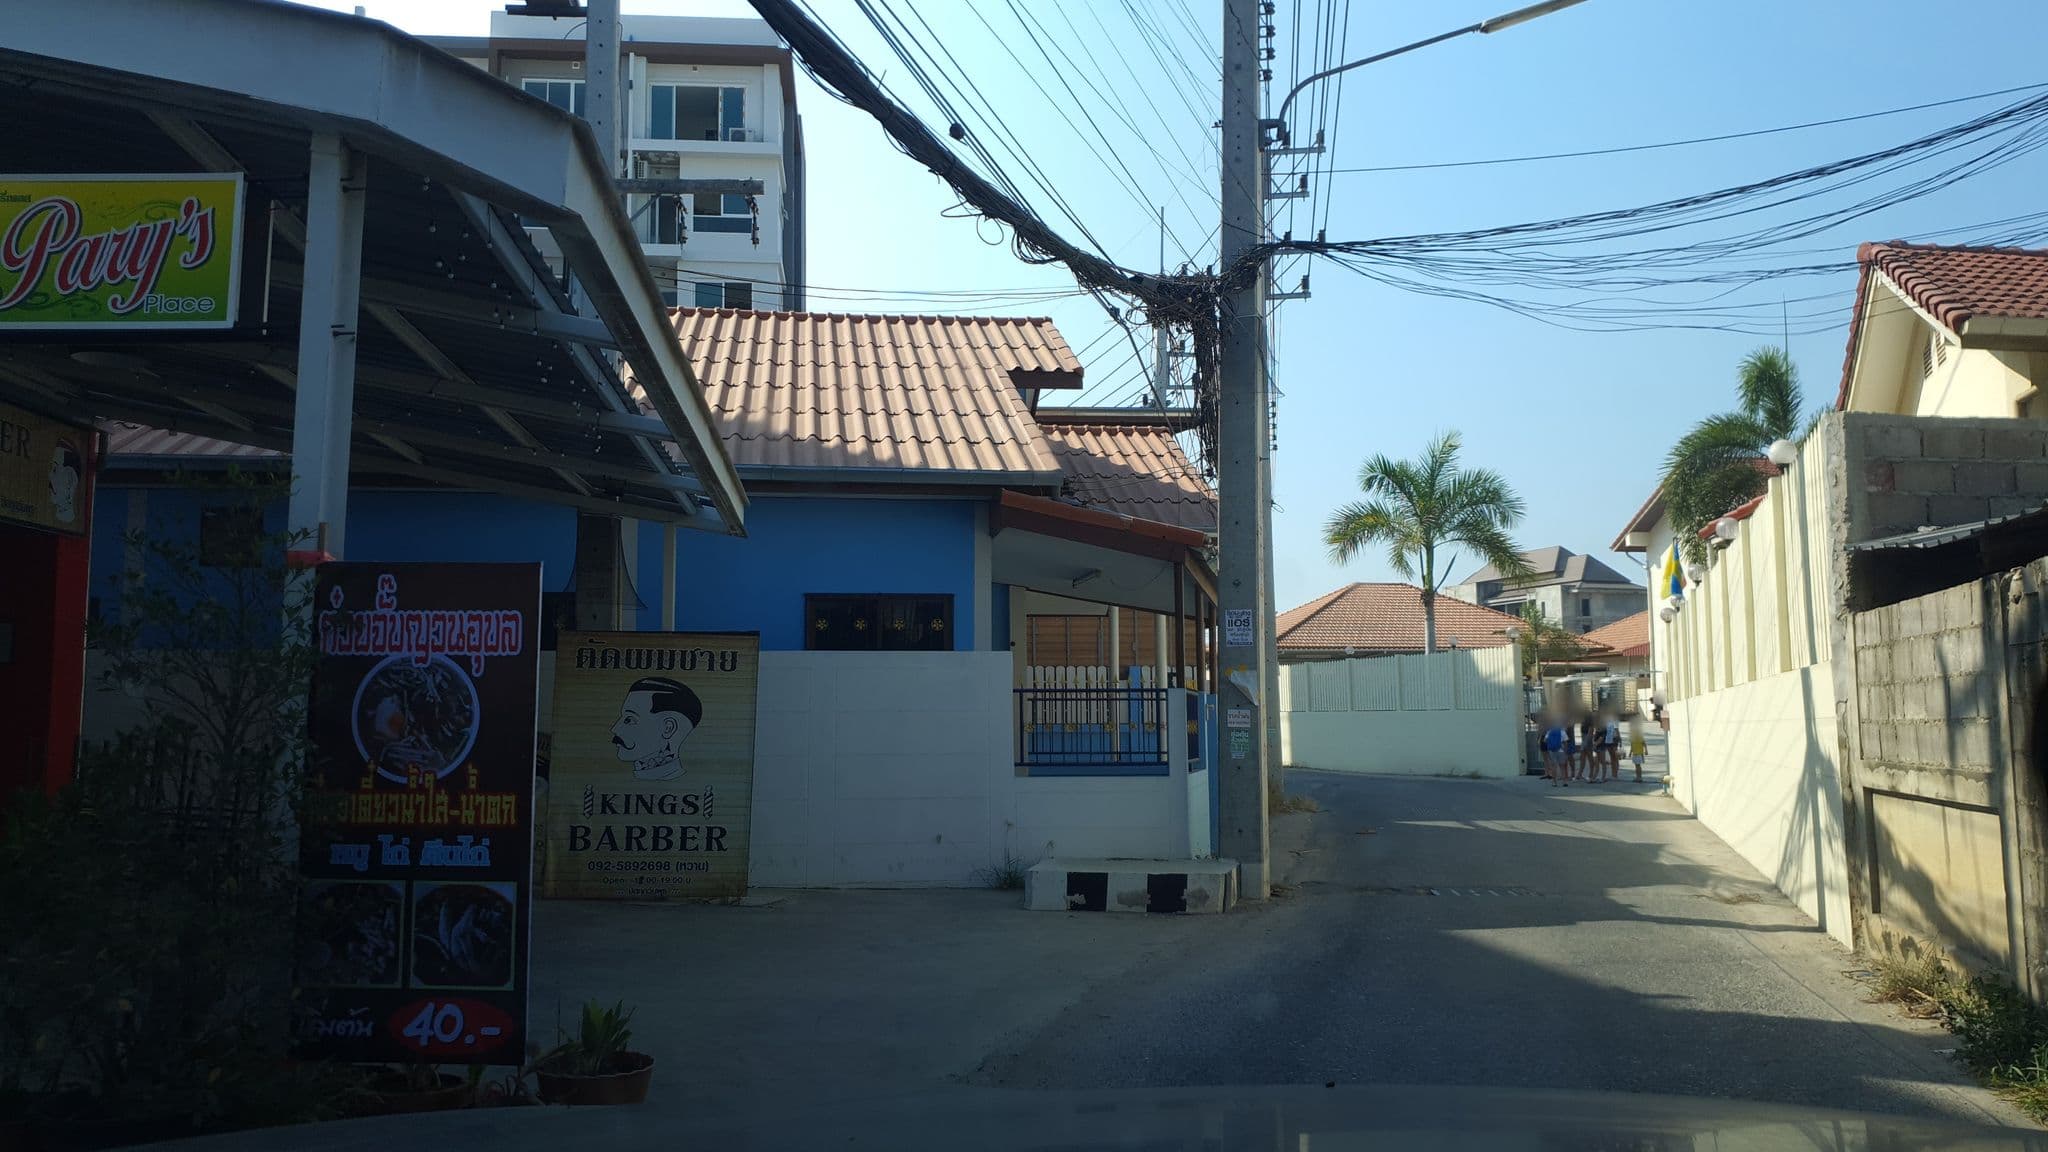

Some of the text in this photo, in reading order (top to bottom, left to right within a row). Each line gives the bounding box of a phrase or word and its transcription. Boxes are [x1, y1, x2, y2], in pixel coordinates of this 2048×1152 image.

[143, 294, 216, 313] Place
[576, 638, 739, 672] ตัดผมชาย
[600, 793, 700, 816] KINGS
[568, 824, 728, 852] BARBER
